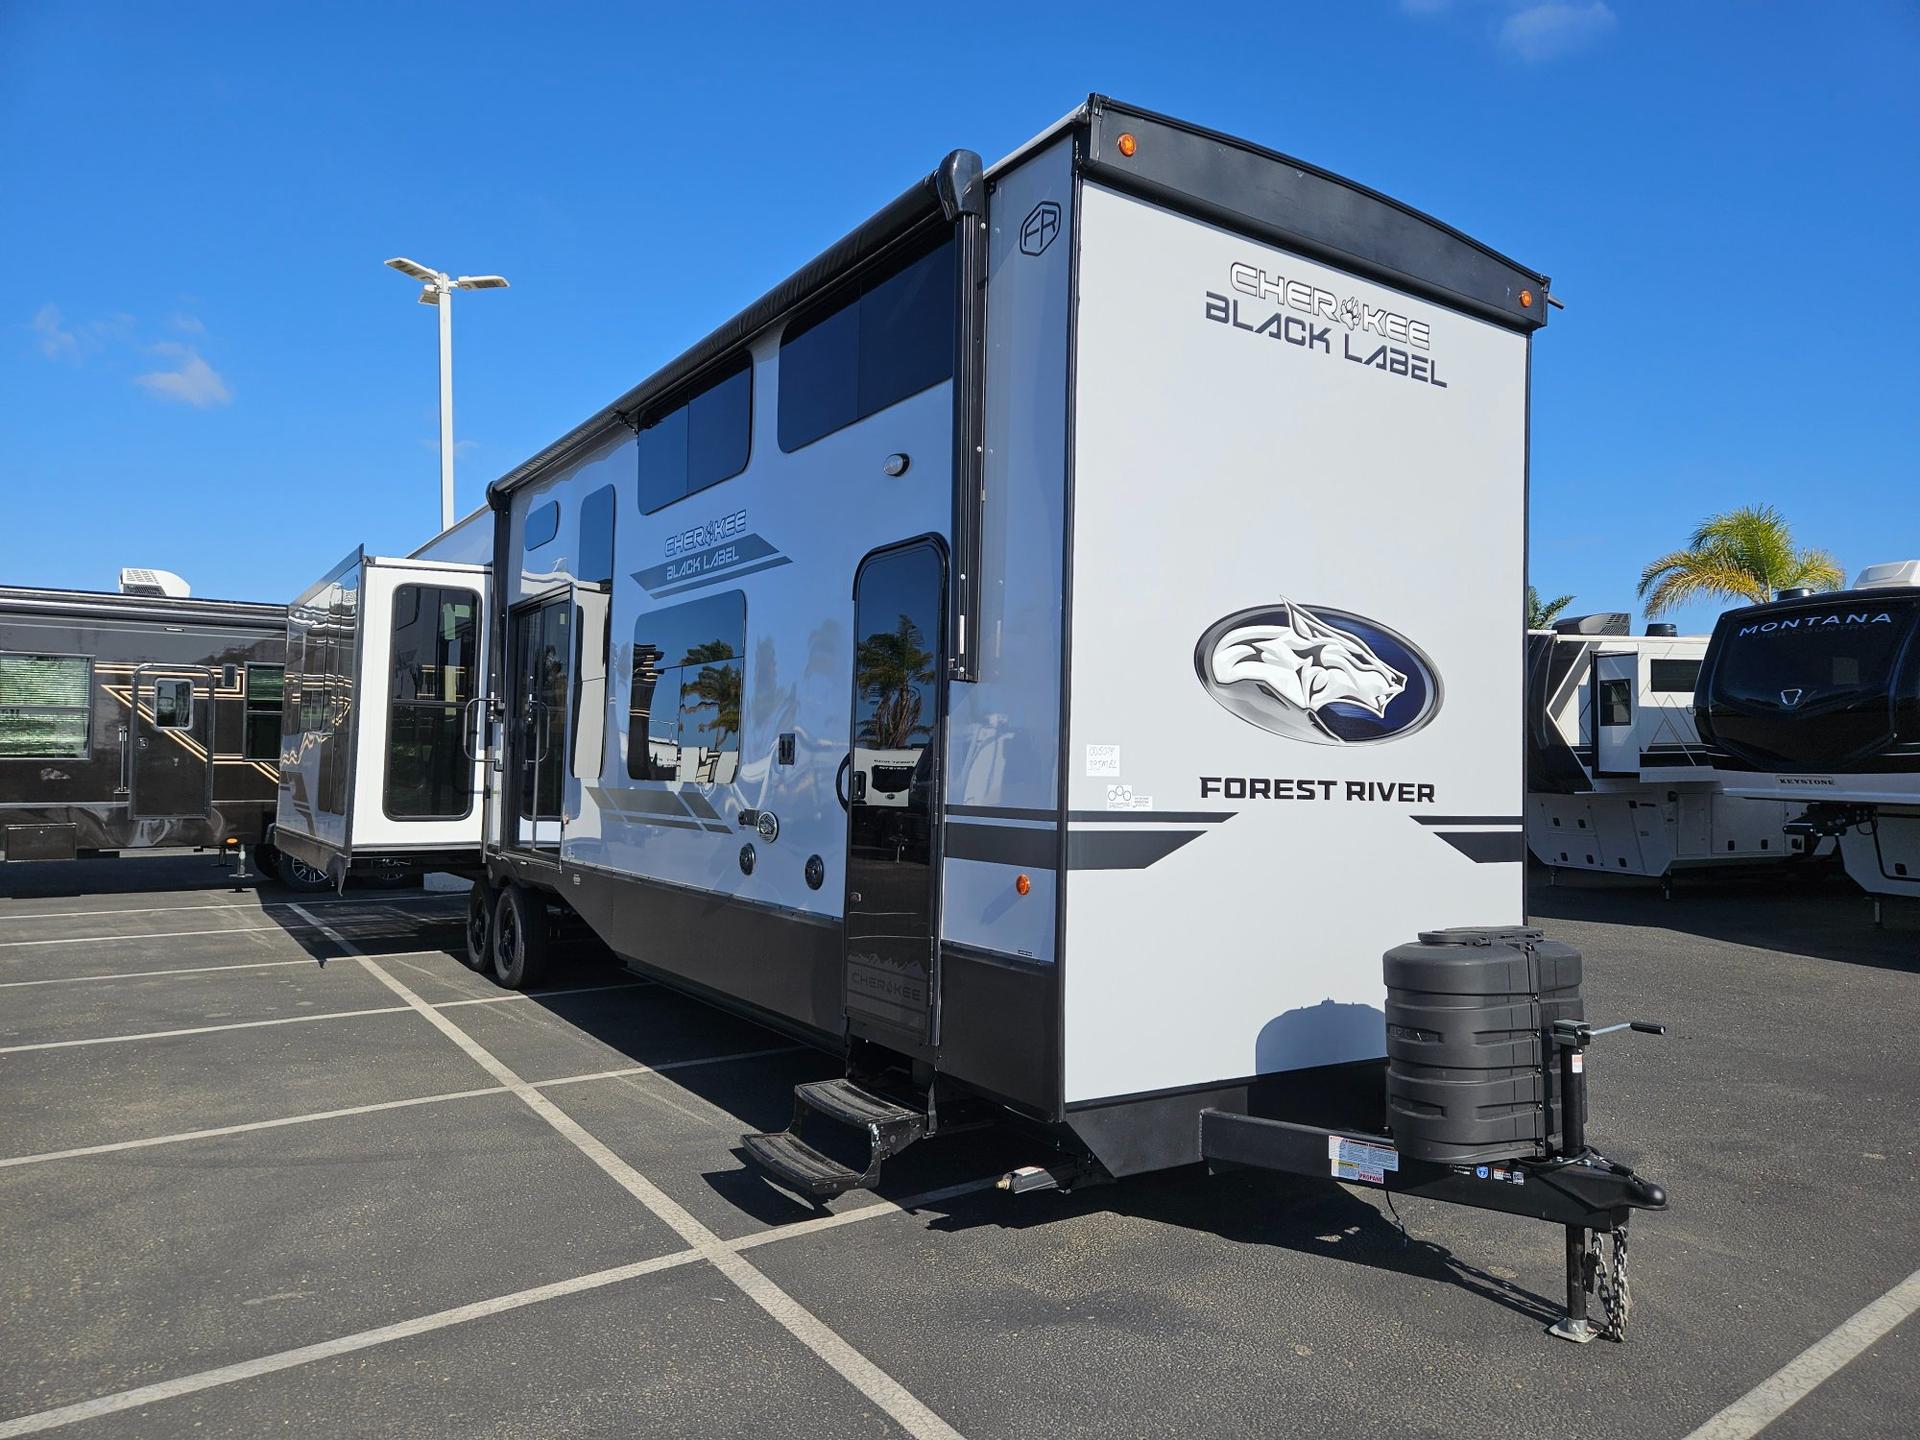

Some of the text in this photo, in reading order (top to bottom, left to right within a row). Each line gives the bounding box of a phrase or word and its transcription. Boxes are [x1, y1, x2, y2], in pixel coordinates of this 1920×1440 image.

[1205, 290, 1448, 389] BLACK LABEL
[666, 545, 740, 580] BLACK LABEL
[1739, 613, 1892, 637] MONTANA
[1199, 776, 1436, 804] FOREST RIVER
[1779, 778, 1836, 786] KEYSTONE
